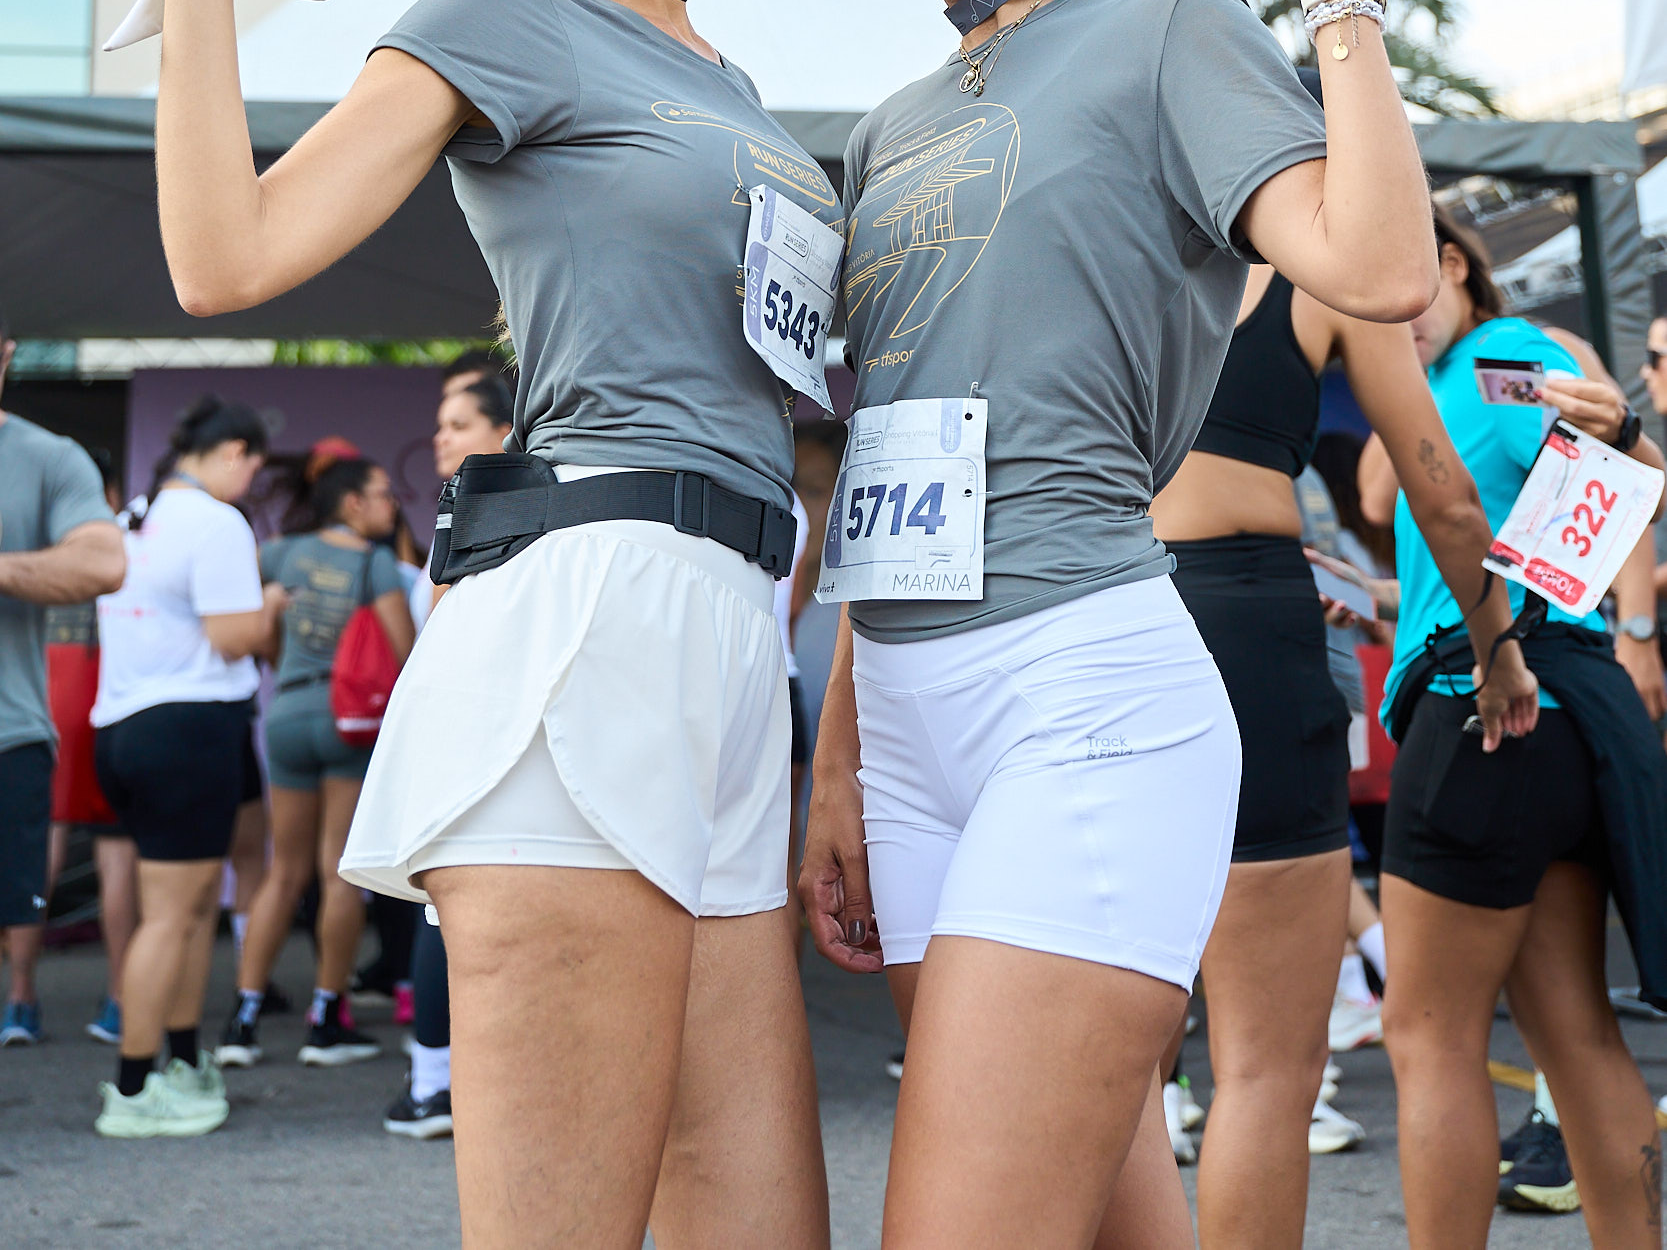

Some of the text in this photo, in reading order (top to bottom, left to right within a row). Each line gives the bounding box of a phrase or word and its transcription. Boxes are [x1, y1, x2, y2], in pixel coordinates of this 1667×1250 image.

[746, 141, 827, 193] RUNSERIES
[750, 265, 760, 318] 5KM
[764, 279, 820, 360] 5343
[846, 482, 947, 541] 5714
[1561, 479, 1618, 557] 322
[892, 573, 971, 592] MARINA
[1086, 735, 1128, 747] Track
